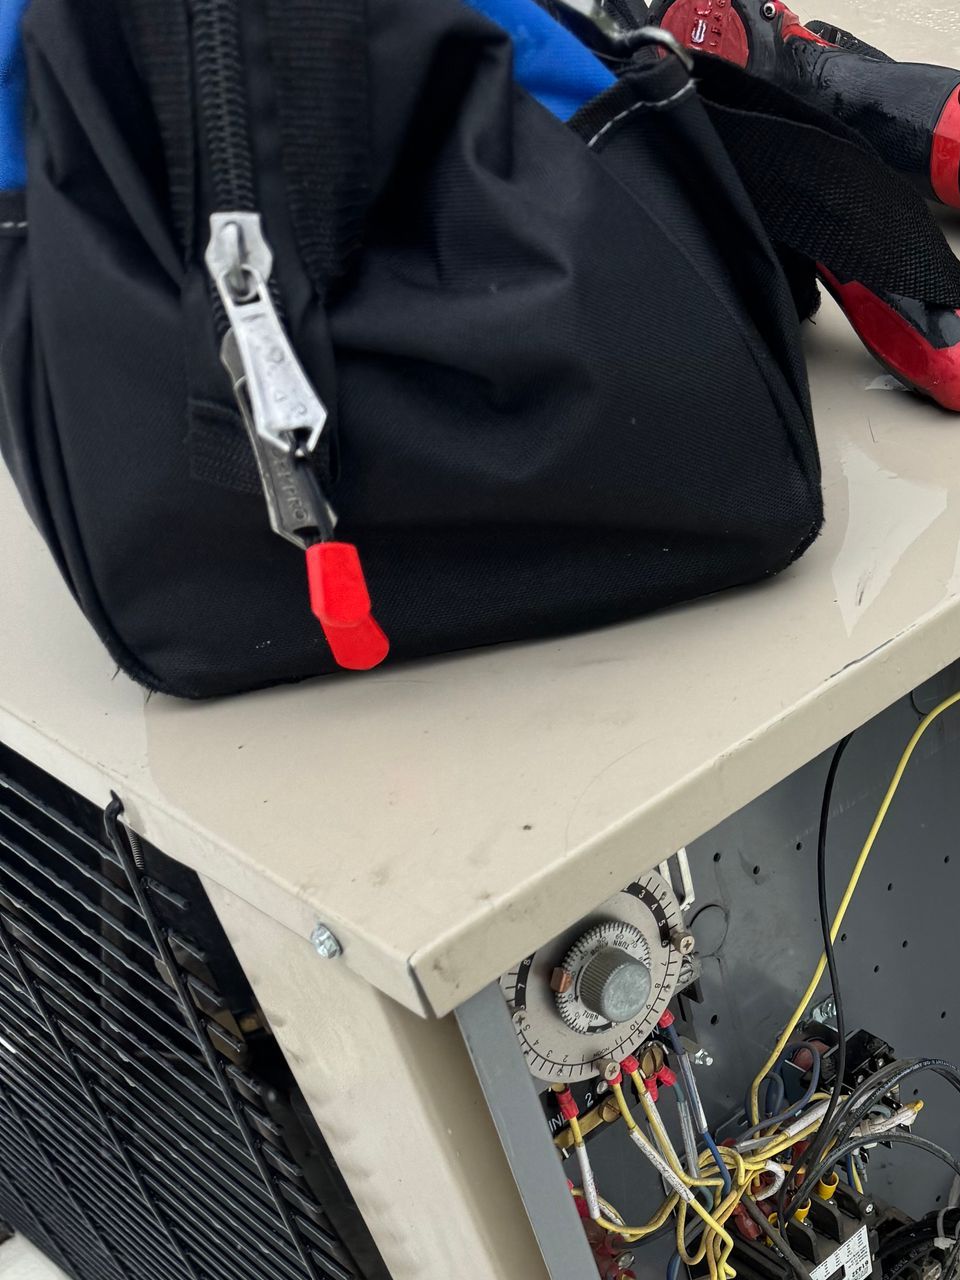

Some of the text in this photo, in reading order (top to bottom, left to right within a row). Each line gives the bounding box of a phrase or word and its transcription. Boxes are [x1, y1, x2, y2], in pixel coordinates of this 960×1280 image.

[638, 889, 646, 899] 3
[650, 903, 659, 911] 4
[658, 919, 666, 927] 5
[612, 939, 630, 950] TURN
[582, 1010, 599, 1020] TURN
[522, 1023, 531, 1032] 5
[629, 1020, 640, 1031] 10
[615, 1035, 623, 1046] 11
[546, 1049, 553, 1058] 3
[562, 1054, 569, 1063] 2
[584, 1092, 594, 1108] 2
